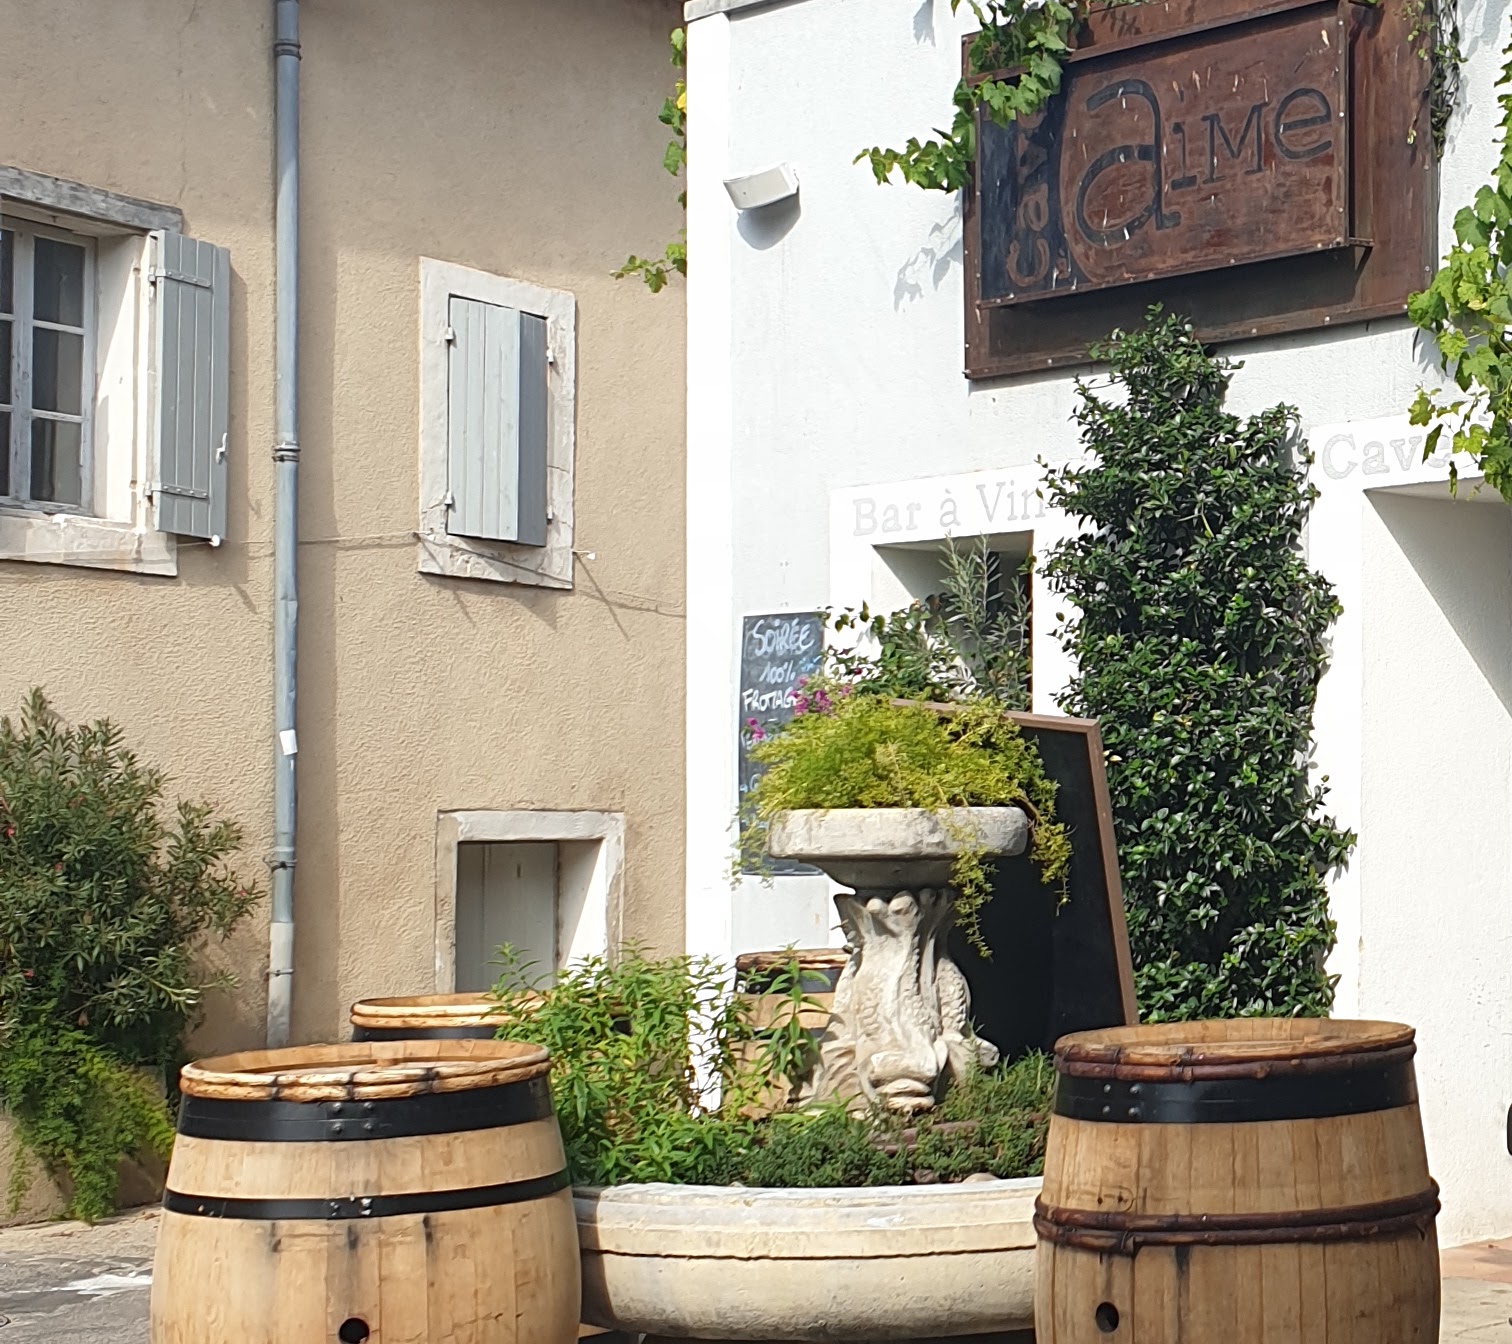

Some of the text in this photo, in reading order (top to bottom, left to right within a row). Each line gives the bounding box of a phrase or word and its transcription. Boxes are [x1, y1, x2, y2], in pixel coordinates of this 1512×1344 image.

[1322, 433, 1452, 481] Cave
[853, 497, 922, 537] Bar
[939, 487, 962, 528] à
[752, 618, 815, 656] SOIRÉE
[759, 660, 796, 685] 100%
